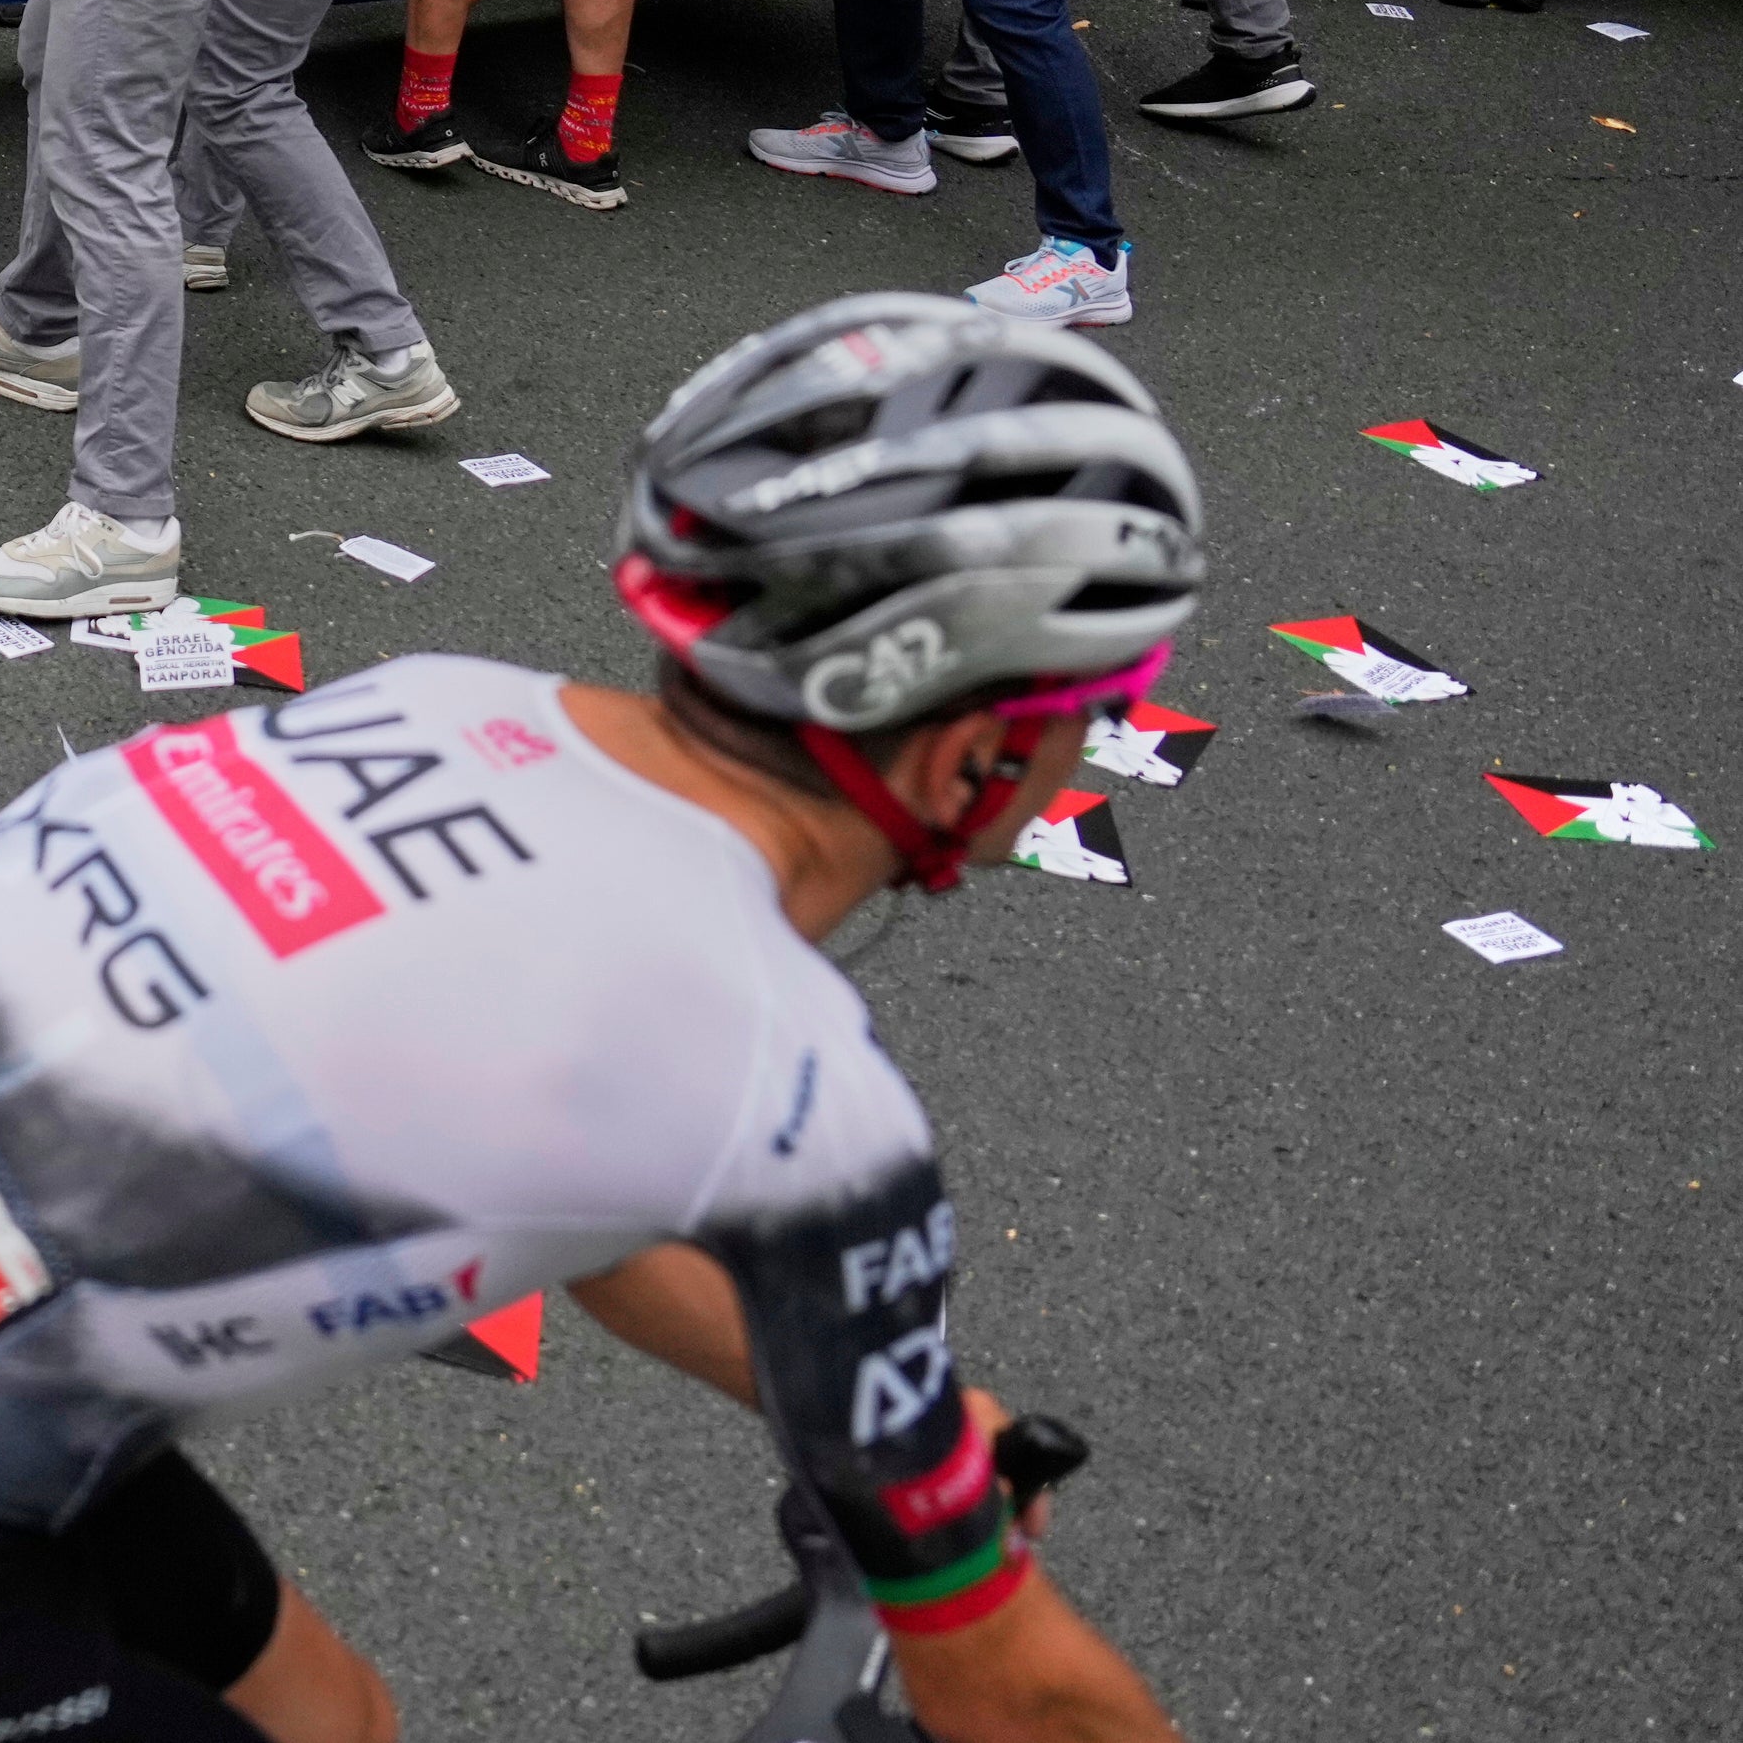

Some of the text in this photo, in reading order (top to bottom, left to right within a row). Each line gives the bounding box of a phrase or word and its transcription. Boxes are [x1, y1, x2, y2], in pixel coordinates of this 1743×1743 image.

[145, 644, 224, 657] GENOZIDA
[156, 633, 210, 646] ISRAEL
[147, 669, 227, 683] KANPORA!
[262, 683, 535, 903] UAE
[150, 728, 330, 923] Emirates
[4, 807, 212, 1033] XRG
[305, 1285, 452, 1340] FAB
